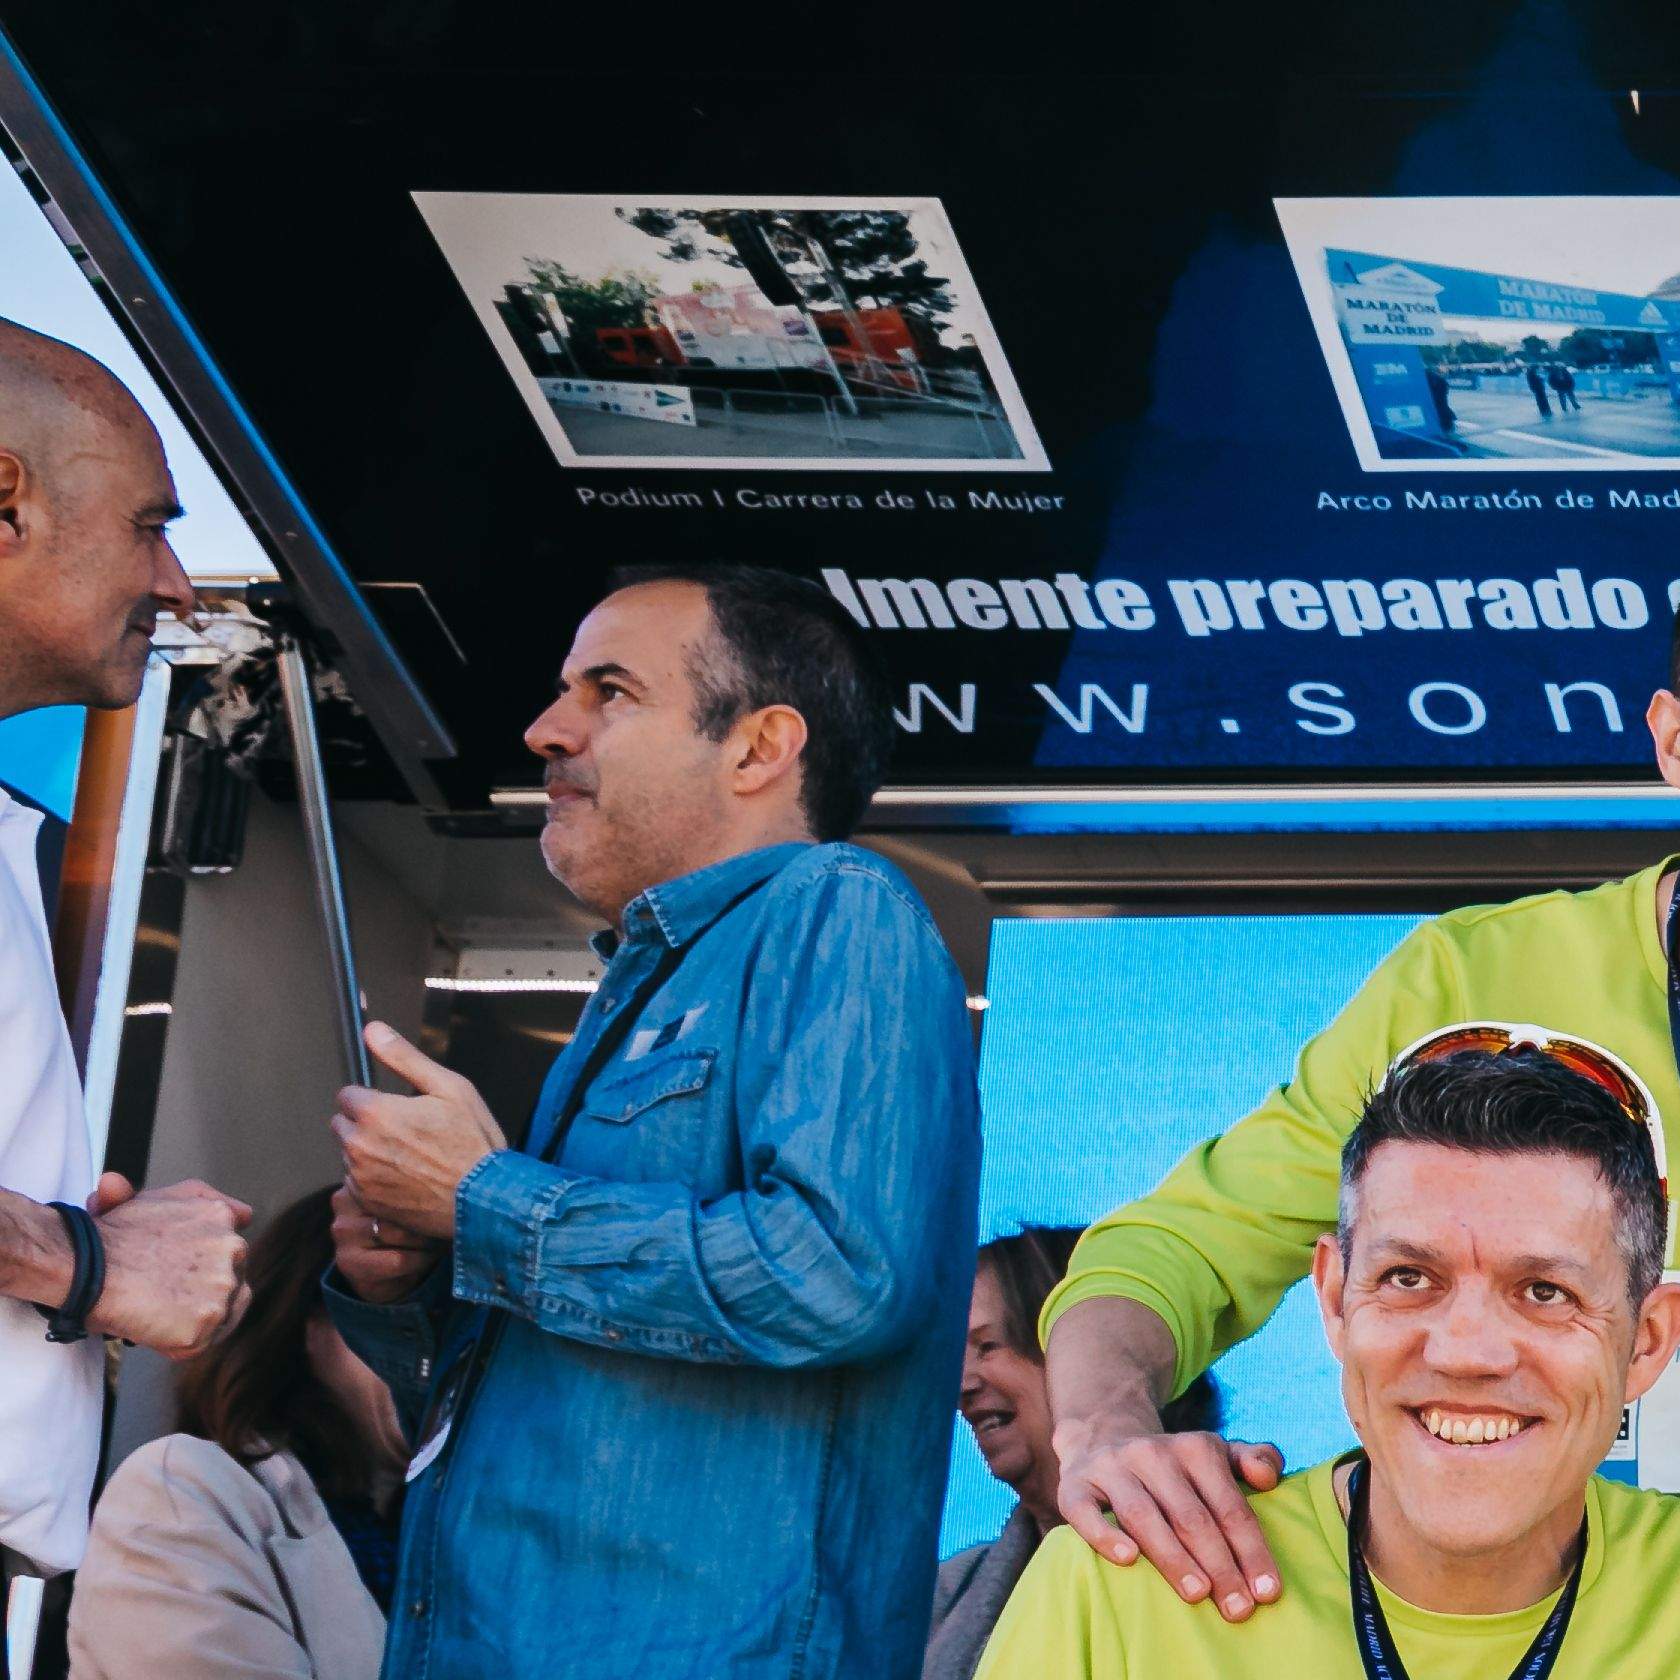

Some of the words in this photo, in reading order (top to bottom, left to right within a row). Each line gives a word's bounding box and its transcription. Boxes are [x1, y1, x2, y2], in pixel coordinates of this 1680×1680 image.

[1363, 323, 1434, 336] MADRID
[576, 487, 702, 511] Podium
[737, 490, 865, 511] Carrera
[875, 490, 918, 511] de
[926, 491, 958, 511] la
[968, 490, 1066, 513] Mujer
[1317, 491, 1392, 511] Arco
[1405, 488, 1543, 511] Maratón
[1556, 489, 1597, 511] de
[1166, 568, 1650, 638] preparado
